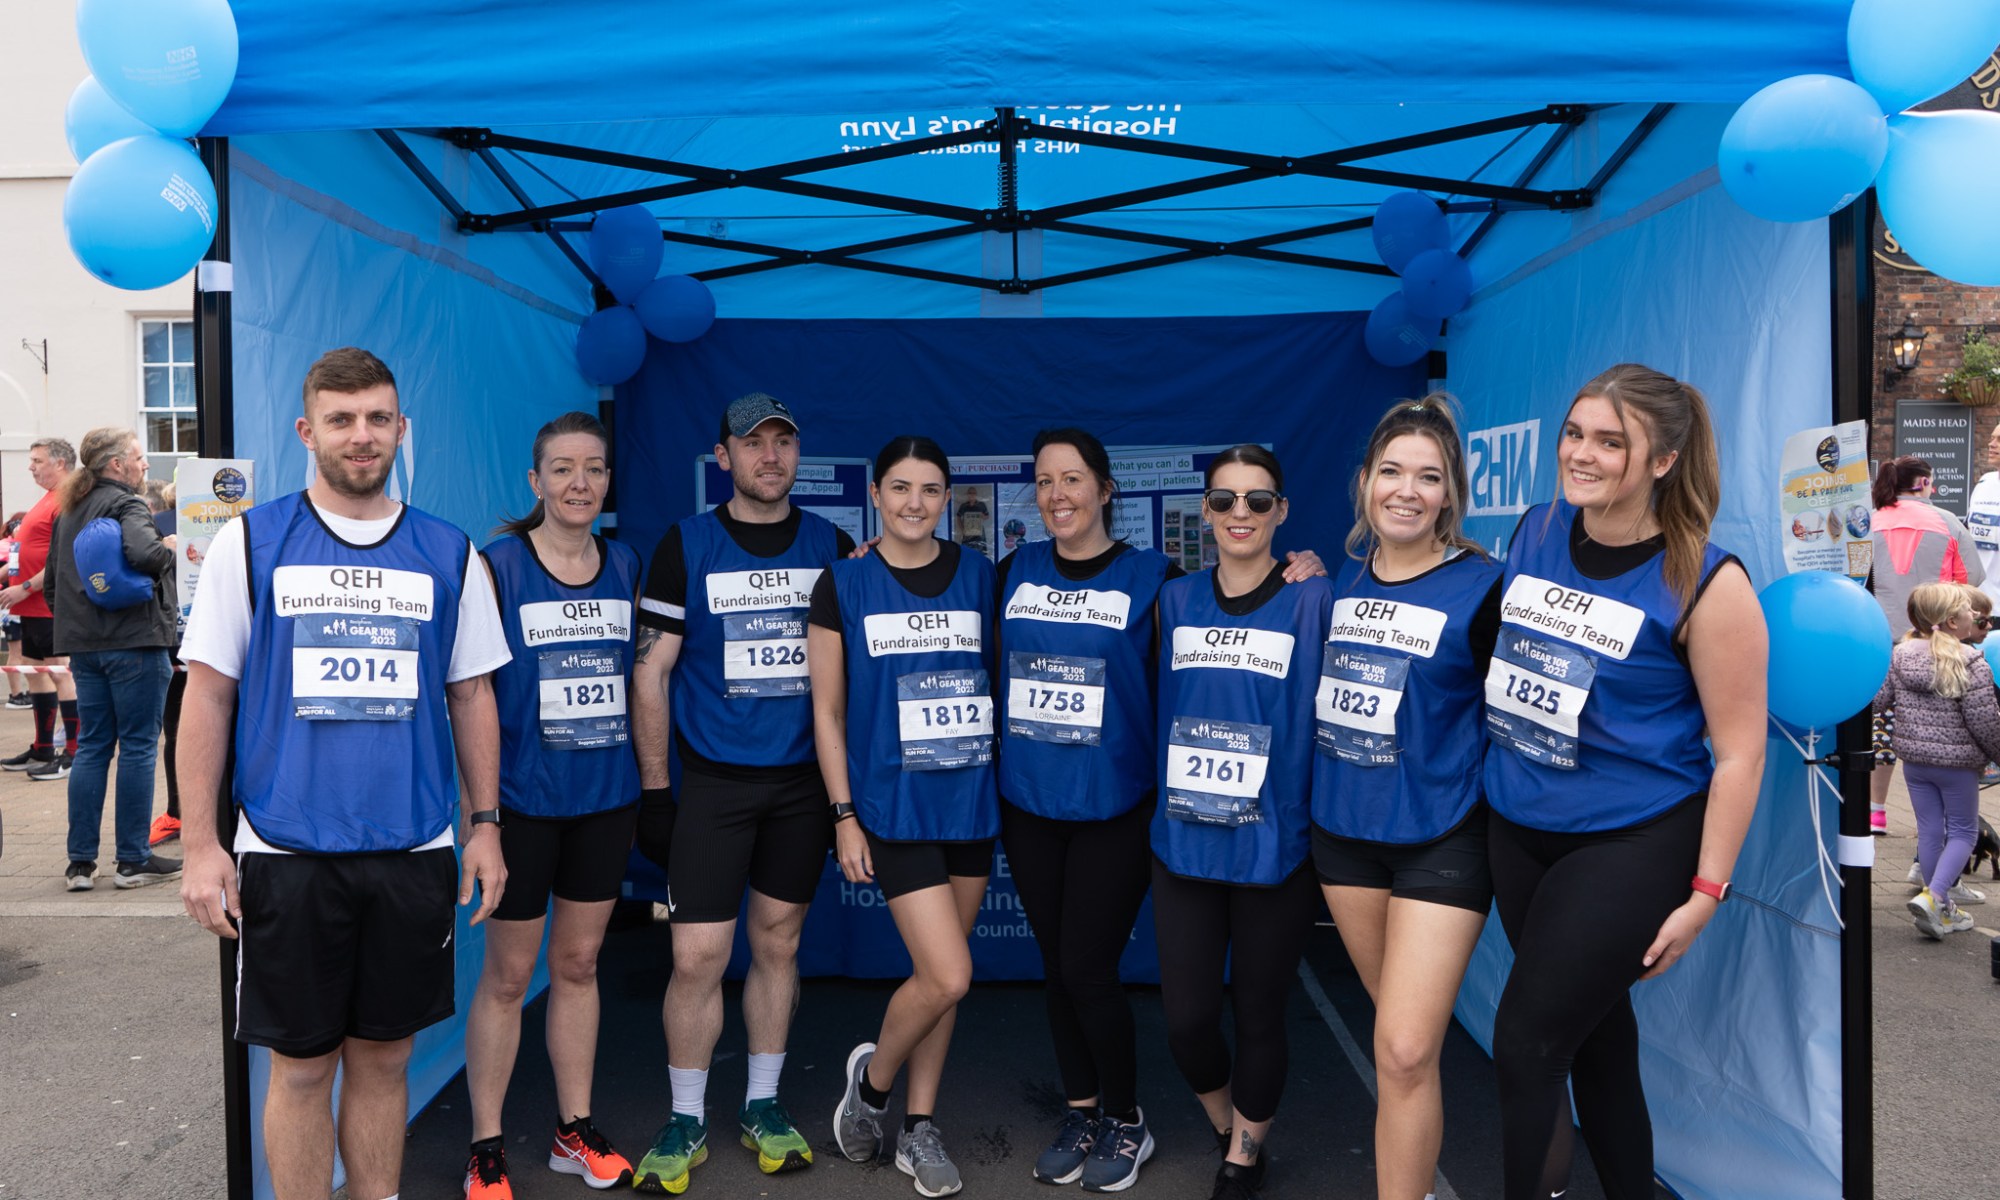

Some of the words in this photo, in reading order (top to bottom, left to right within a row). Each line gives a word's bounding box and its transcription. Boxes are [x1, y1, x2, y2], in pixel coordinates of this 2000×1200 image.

[1902, 418, 1936, 428] MAIDS
[1938, 418, 1967, 427] HEAD
[968, 464, 1018, 472] PURCHASED
[1111, 462, 1134, 470] What
[1136, 462, 1153, 471] you
[1178, 459, 1190, 468] do
[1141, 479, 1156, 487] our
[1163, 475, 1201, 486] patients
[811, 483, 841, 494] Appeal
[1796, 489, 1808, 498] BE
[200, 505, 232, 516] JOIN
[206, 516, 211, 524] A
[1972, 526, 1991, 537] 1087
[330, 568, 382, 590] QEH
[749, 571, 790, 590] QEH
[282, 593, 381, 613] Fundraising
[387, 597, 428, 614] Team
[714, 593, 791, 609] Fundraising
[794, 592, 812, 603] Tea
[1047, 591, 1088, 606] QEH
[1544, 587, 1594, 615] QEH
[563, 602, 602, 620] QEH
[1008, 604, 1081, 621] Fundraising
[1086, 609, 1122, 625] Team
[1354, 600, 1397, 622] QEH
[908, 613, 949, 632] QEH
[1502, 602, 1577, 638] Fundraising
[1581, 625, 1624, 653] Team
[350, 626, 378, 635] GEAR
[380, 627, 396, 637] 10K
[528, 624, 604, 641] Fundraising
[606, 623, 627, 637] Team
[782, 628, 802, 636] 2023
[1205, 629, 1248, 647] QEH
[371, 636, 396, 645] 2023
[872, 636, 950, 651] Fundraising
[1391, 629, 1430, 651] Team
[580, 659, 602, 667] GEAR
[602, 658, 614, 666] 10K
[747, 646, 806, 666] 1826
[1174, 650, 1240, 666] Fundraising
[1246, 653, 1283, 673] Team
[1530, 649, 1551, 664] GEAR
[1552, 656, 1571, 669] 10K
[320, 657, 398, 682] 2014
[596, 665, 614, 673] 2023
[1048, 664, 1069, 674] GEAR
[1071, 666, 1085, 675] 10K
[1349, 661, 1371, 673] GEAR
[1371, 665, 1387, 676] 10K
[1543, 664, 1567, 678] 2023
[939, 680, 960, 688] GEAR
[1062, 673, 1085, 682] 2023
[1362, 672, 1386, 684] 2023
[564, 684, 615, 706] 1821
[956, 686, 975, 694] 2023
[1506, 674, 1560, 715] 1825
[1028, 688, 1085, 713] 1758
[1332, 688, 1380, 718] 1823
[922, 704, 980, 727] 1812
[1035, 712, 1072, 722] LORRAINE
[946, 728, 959, 736] FAY
[1211, 730, 1234, 741] GEAR
[1235, 733, 1250, 742] 10K
[1227, 740, 1250, 750] 2023
[1371, 754, 1394, 763] 1823
[1551, 754, 1574, 767] 1825
[1186, 756, 1245, 783] 2161
[1237, 814, 1260, 823] 2161
